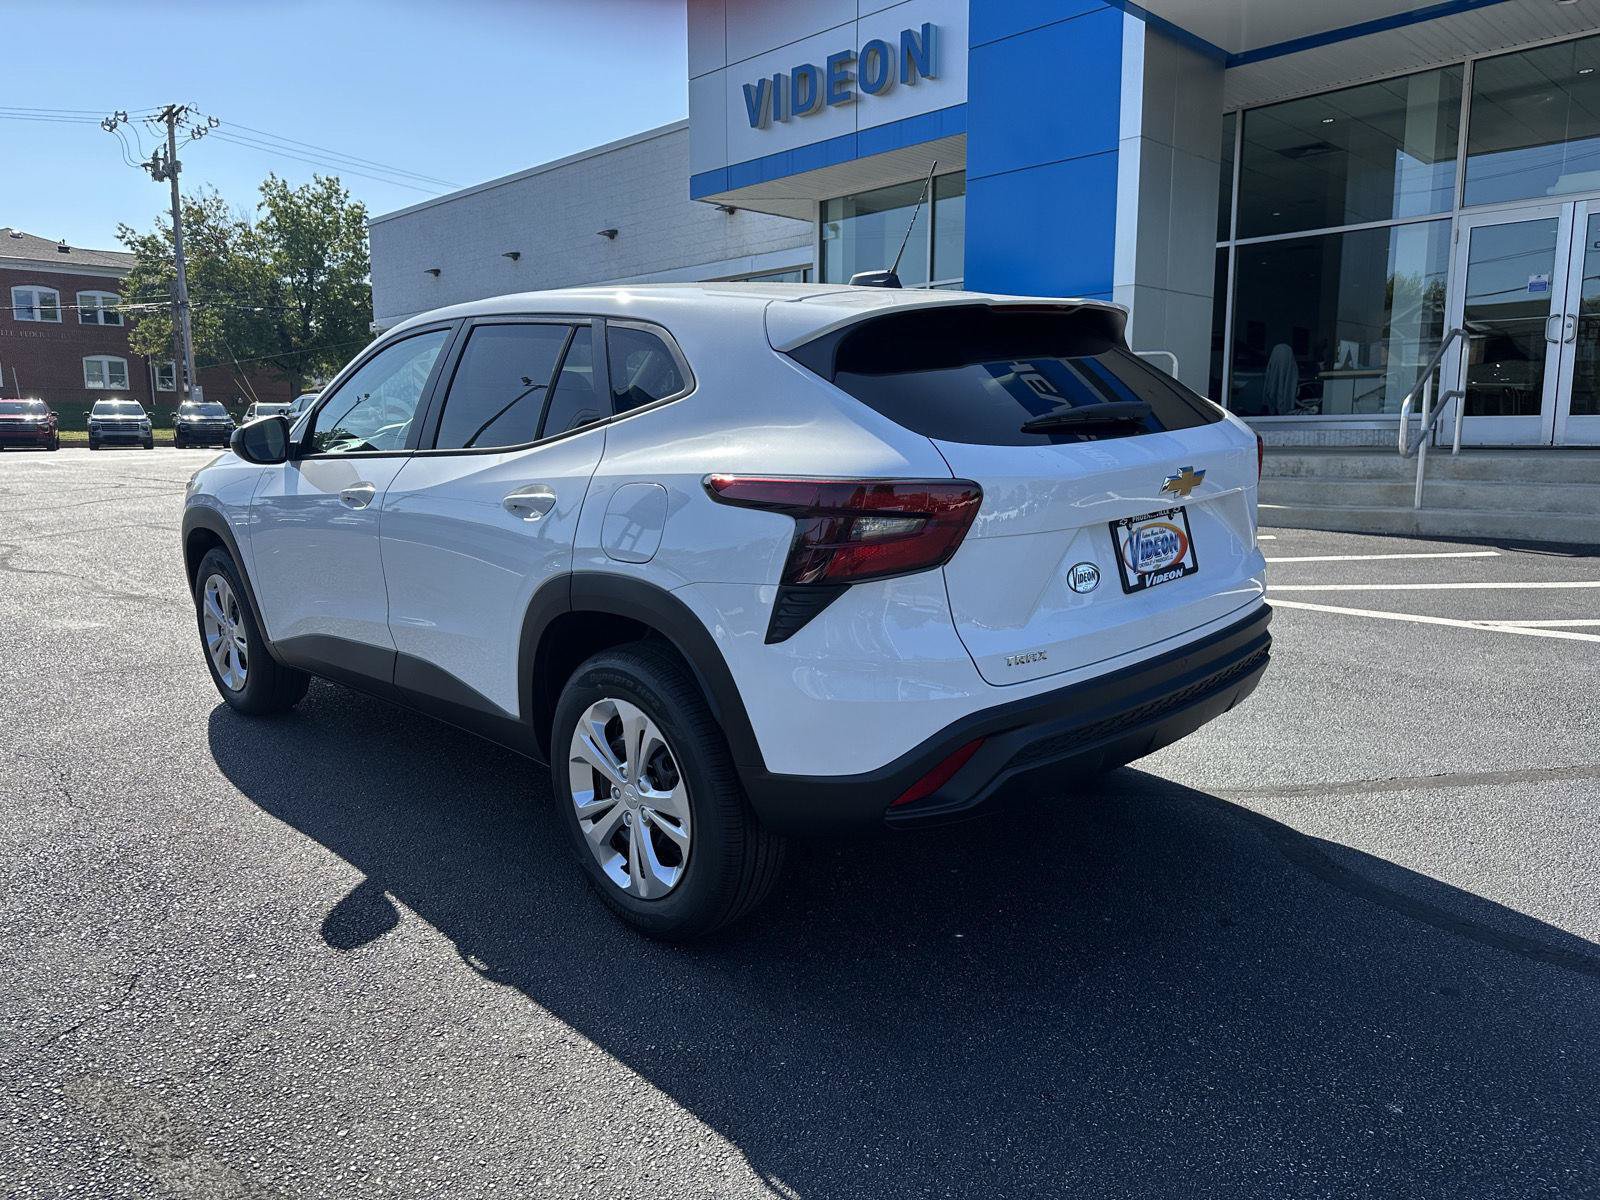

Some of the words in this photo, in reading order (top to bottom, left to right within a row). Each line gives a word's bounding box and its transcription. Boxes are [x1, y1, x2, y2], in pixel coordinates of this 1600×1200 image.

[742, 22, 938, 129] VIDEON
[1128, 527, 1179, 575] VIDEON
[1072, 568, 1096, 590] VIDEON
[1145, 568, 1184, 588] VIDEON
